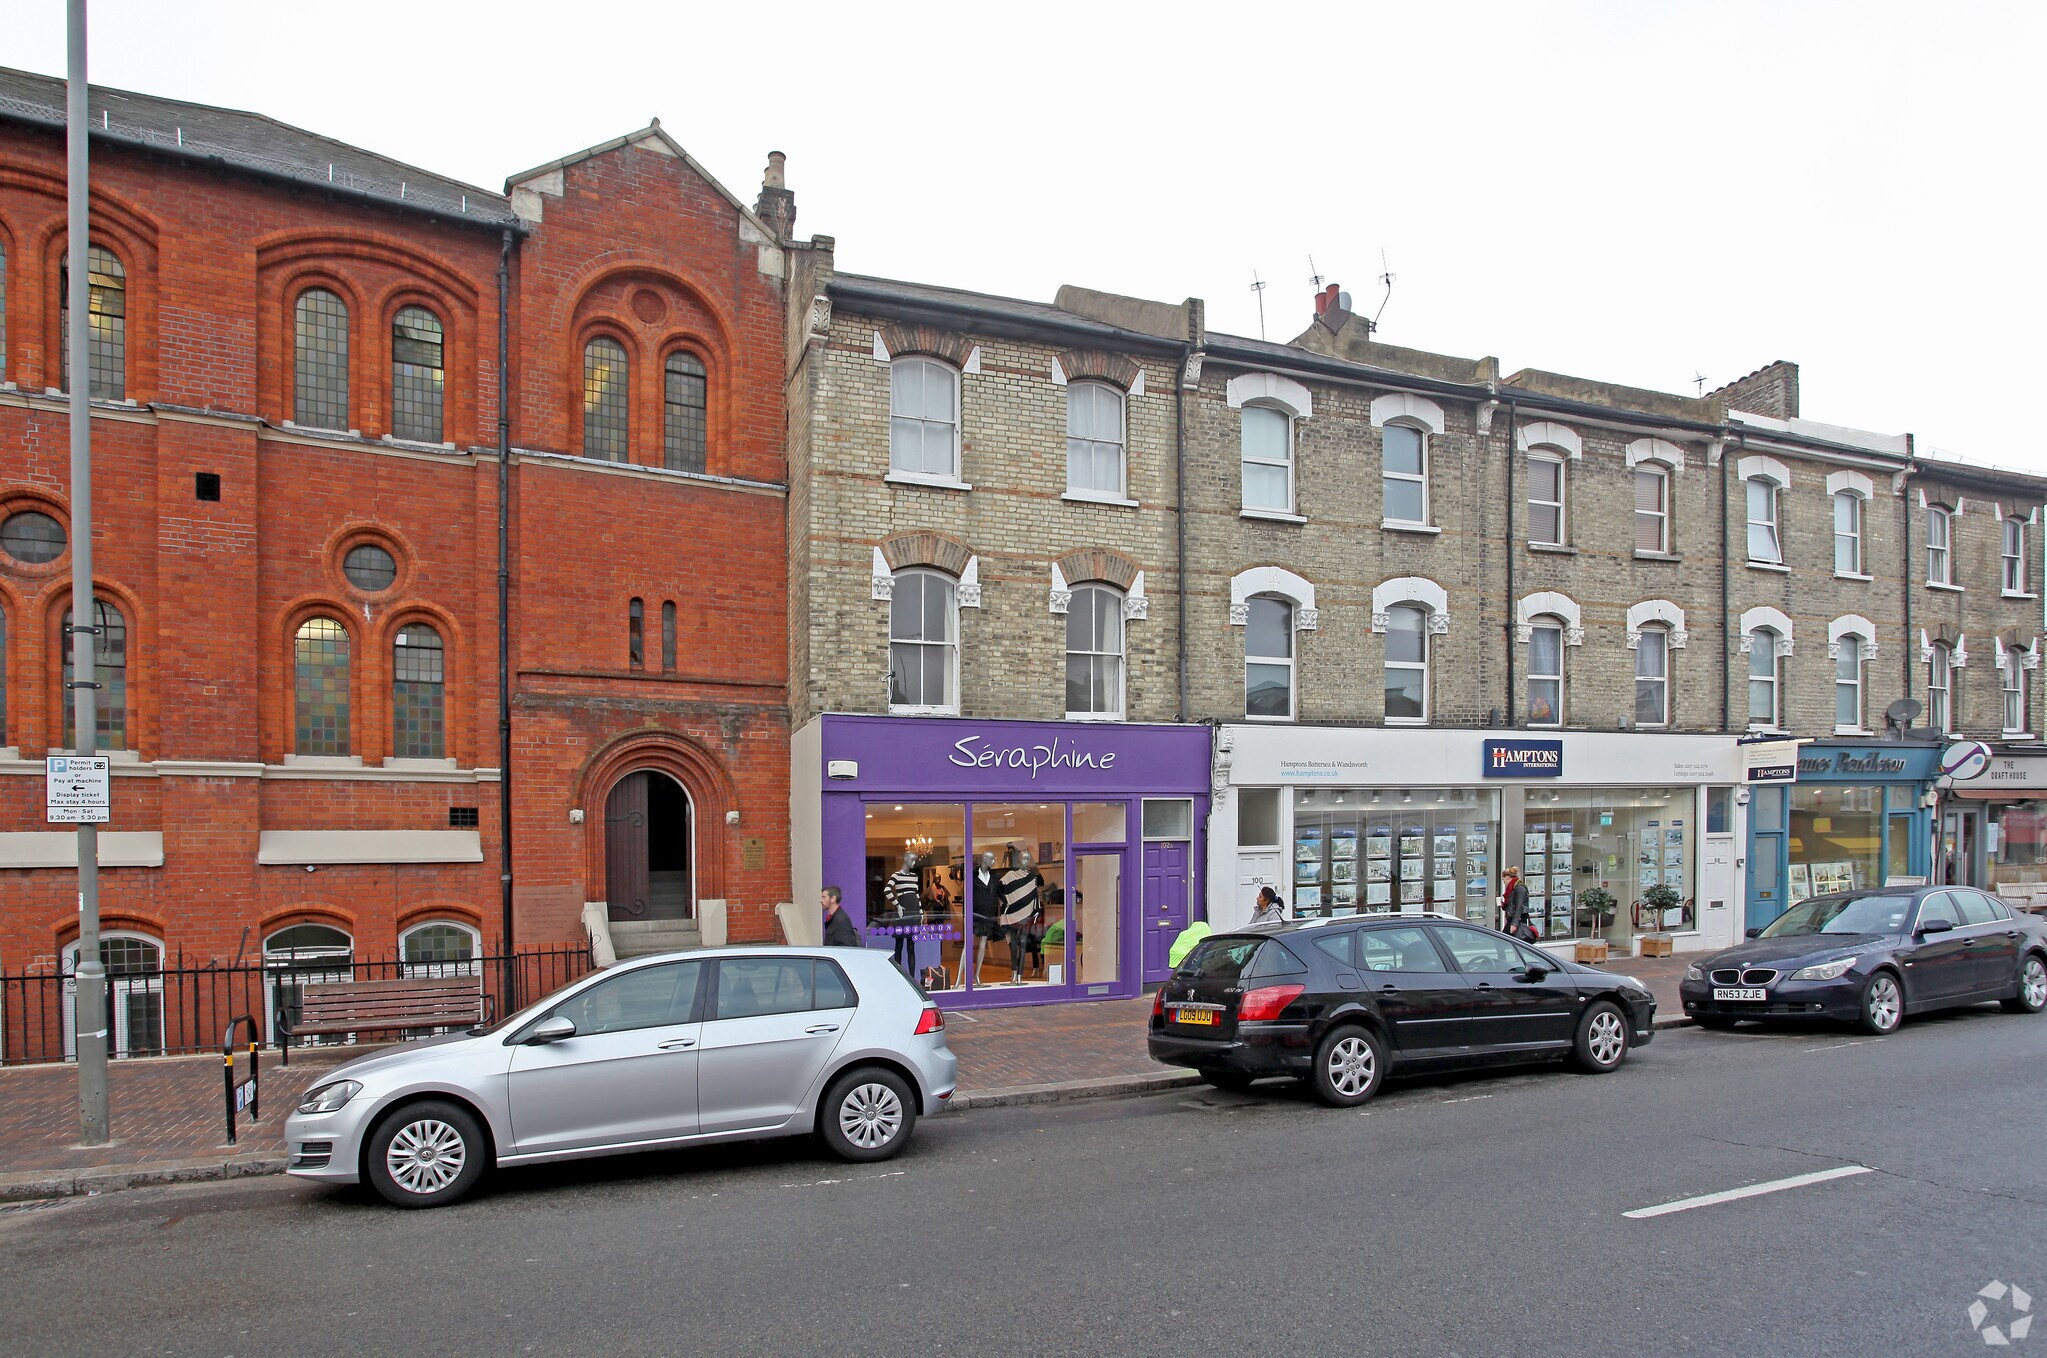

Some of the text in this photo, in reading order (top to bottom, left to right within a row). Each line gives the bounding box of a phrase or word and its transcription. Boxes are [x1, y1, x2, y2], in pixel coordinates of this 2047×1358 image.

[948, 735, 1116, 779] Séraphine
[1492, 747, 1558, 768] HAMPTONS
[1280, 760, 1308, 769] Hamptons
[1308, 760, 1331, 768] Battersea
[1337, 760, 1368, 768] Wandsworth
[1797, 751, 1906, 773] ames Pendleton
[2004, 761, 2014, 769] THE
[1757, 768, 1790, 777] HAMPTONS
[905, 924, 953, 933] SEASON
[1717, 990, 1761, 999] RN53 ZJE
